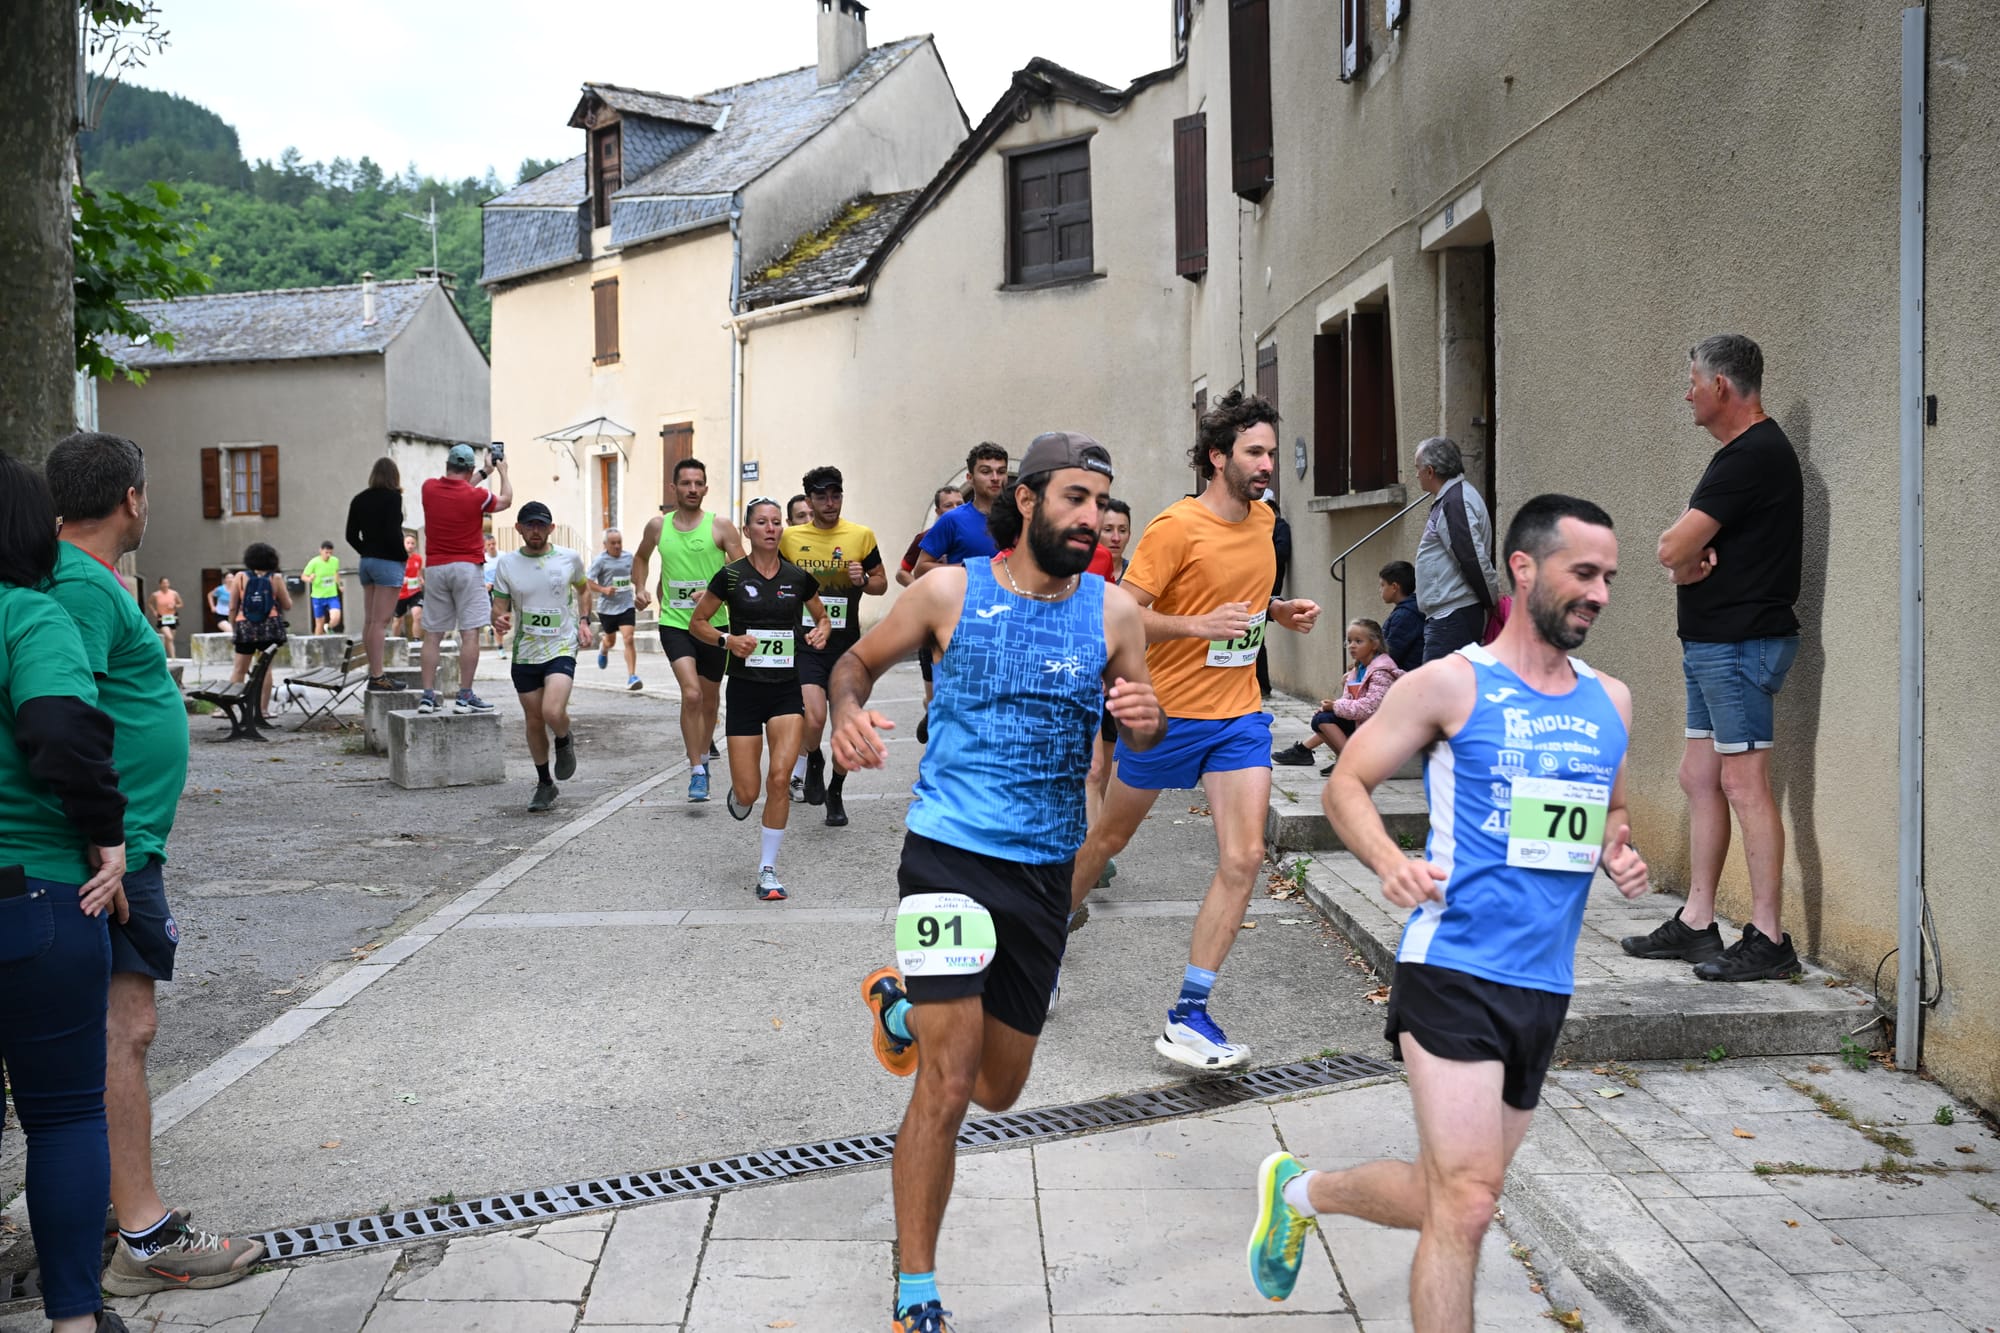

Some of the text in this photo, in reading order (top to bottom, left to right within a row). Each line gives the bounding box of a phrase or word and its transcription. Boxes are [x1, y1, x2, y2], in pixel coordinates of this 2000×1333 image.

[531, 614, 551, 627] 20
[760, 640, 783, 655] 78
[1543, 804, 1587, 841] 70
[917, 915, 962, 948] 91
